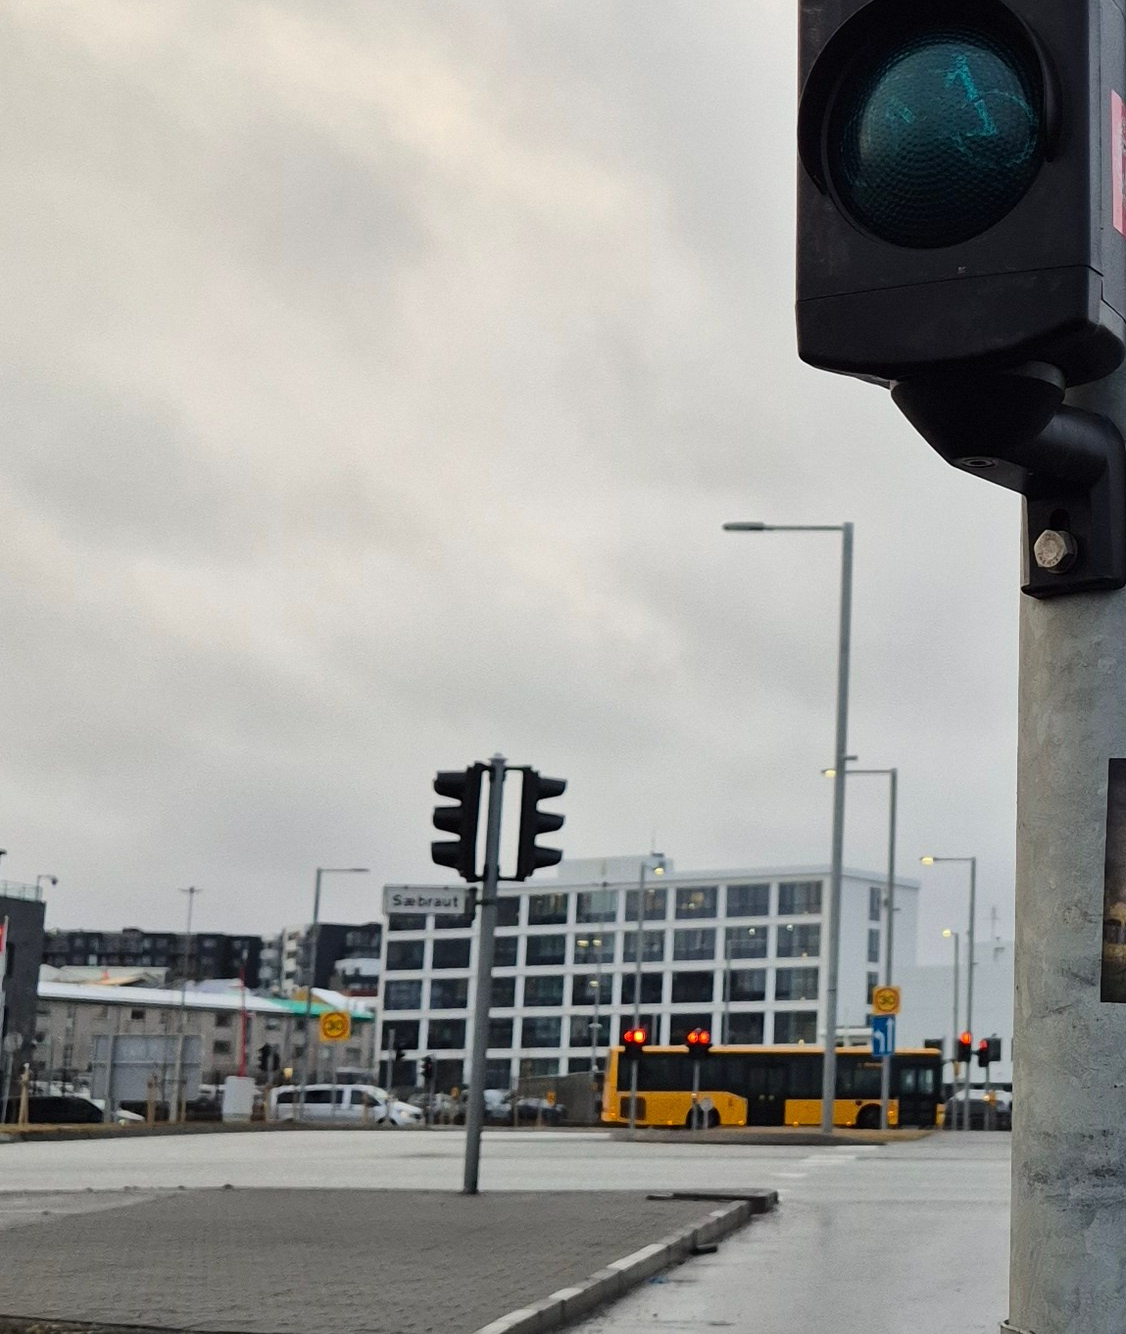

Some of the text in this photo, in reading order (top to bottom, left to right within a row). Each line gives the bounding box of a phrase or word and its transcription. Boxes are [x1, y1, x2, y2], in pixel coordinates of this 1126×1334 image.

[392, 893, 458, 908] Sæbraut
[879, 994, 895, 1006] 30
[326, 1019, 343, 1032] 30
